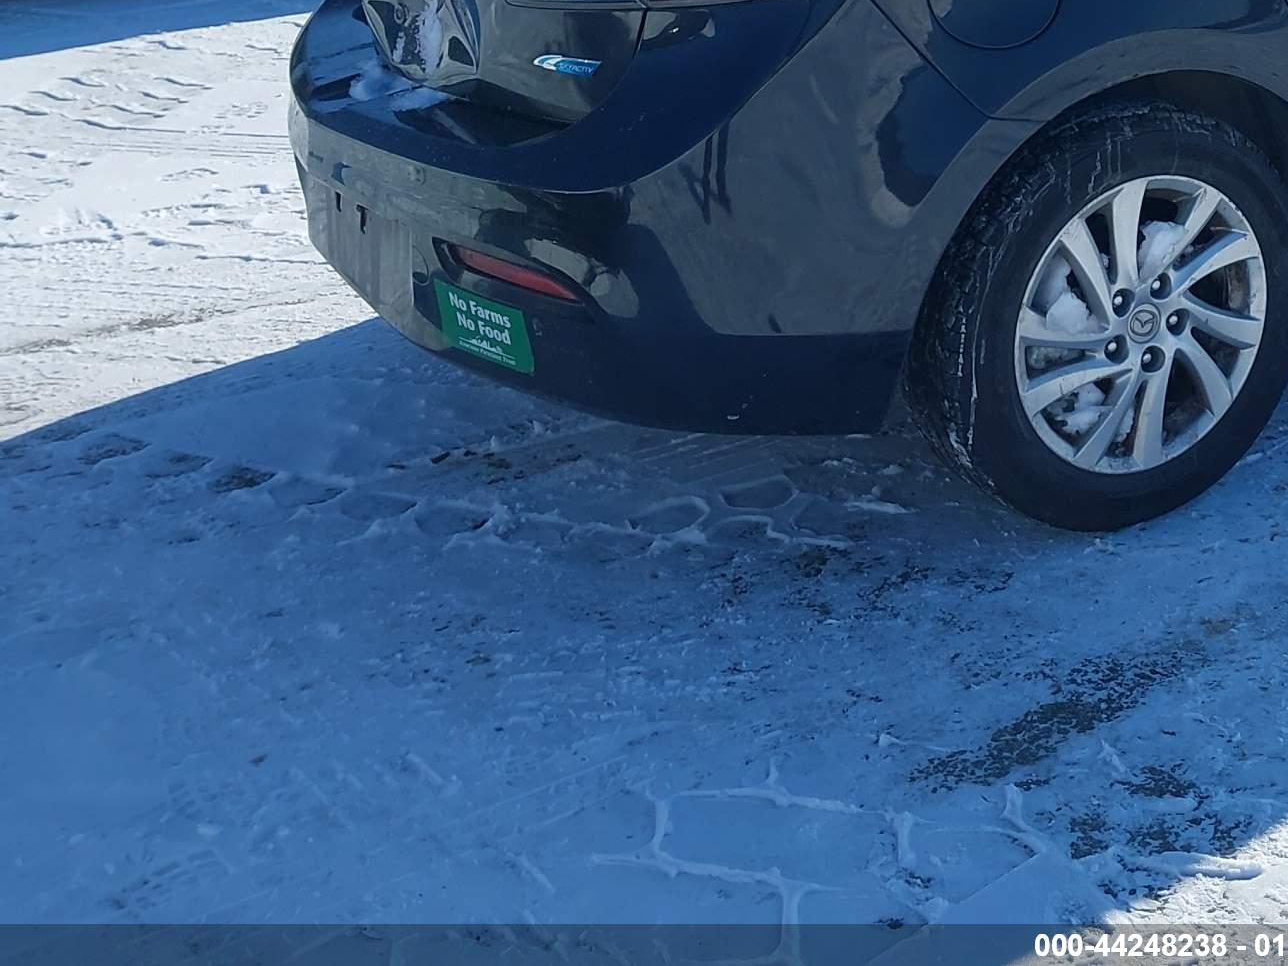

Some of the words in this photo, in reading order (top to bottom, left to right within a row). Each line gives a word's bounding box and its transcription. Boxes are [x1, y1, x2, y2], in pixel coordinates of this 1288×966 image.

[448, 291, 467, 312] No
[469, 299, 511, 328] Farms
[456, 311, 476, 332] No
[477, 319, 511, 346] Food
